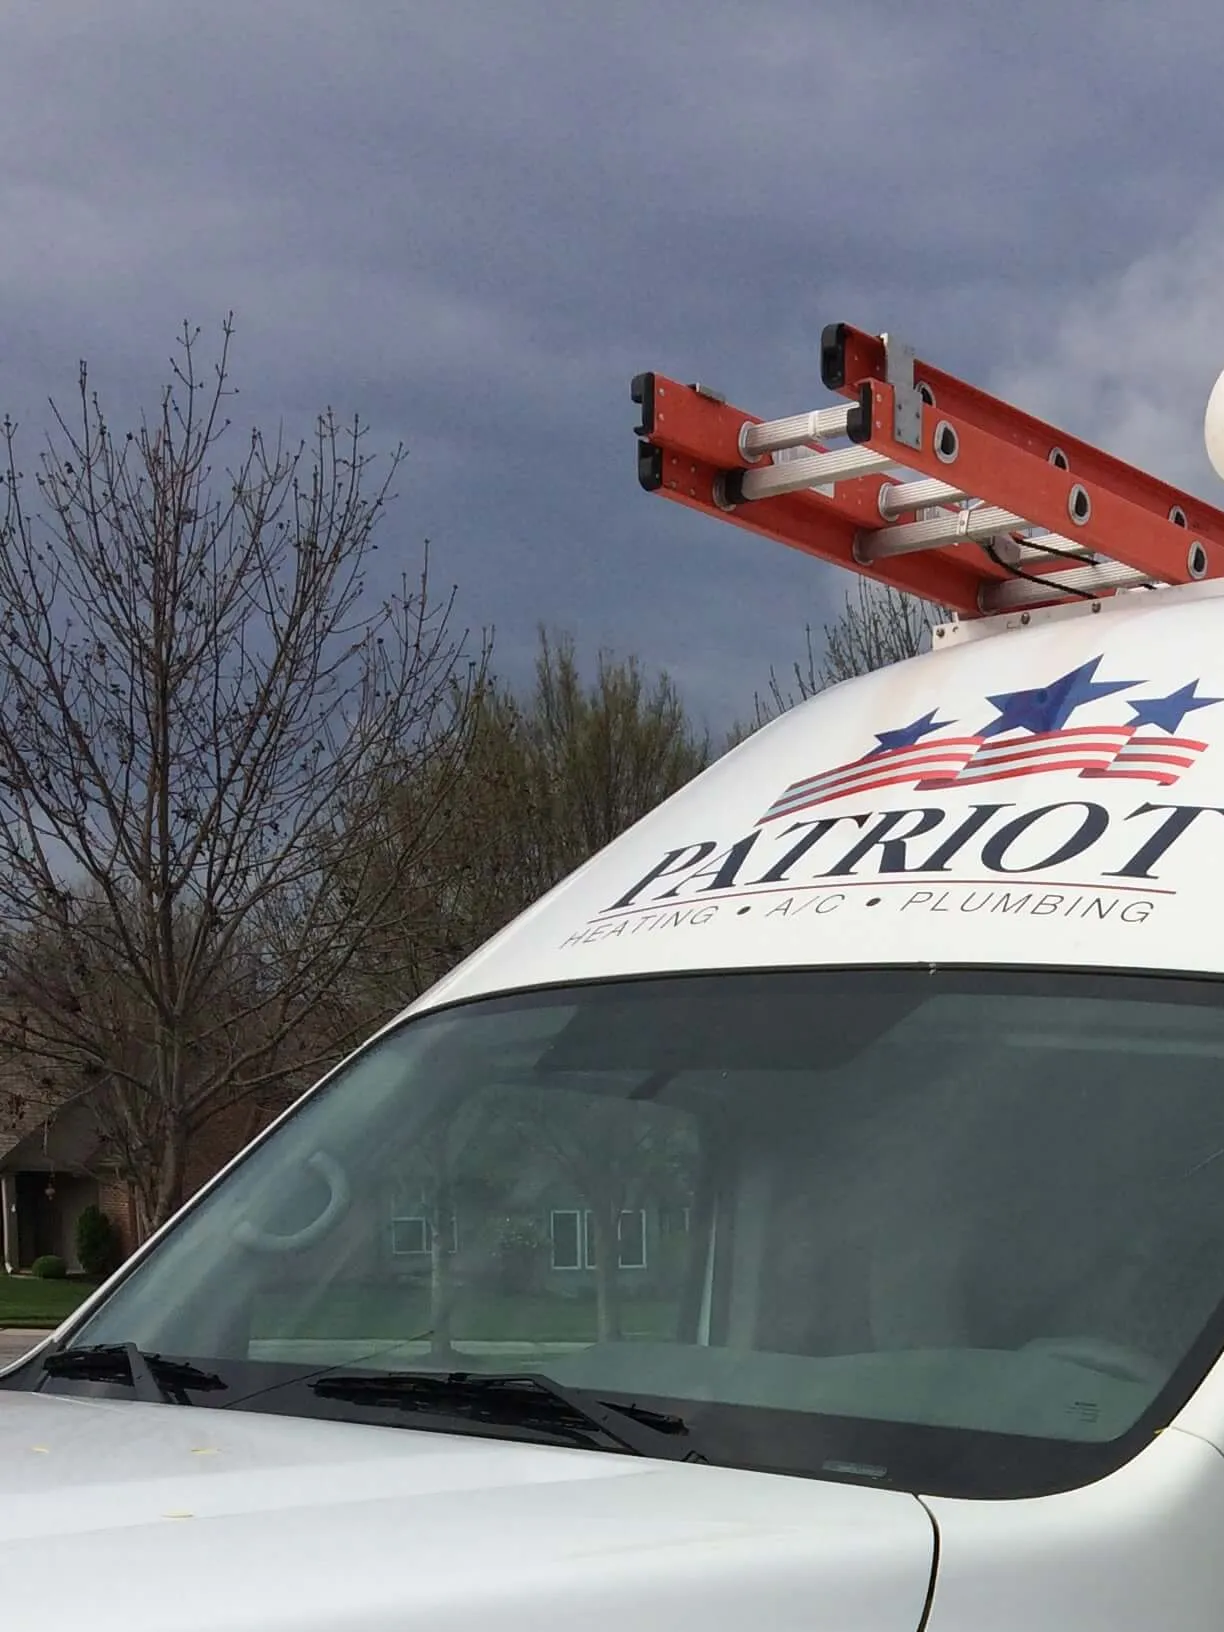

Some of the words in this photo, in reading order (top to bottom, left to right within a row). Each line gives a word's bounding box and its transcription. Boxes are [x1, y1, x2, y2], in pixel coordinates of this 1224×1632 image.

[560, 905, 719, 949] HEATING
[766, 894, 845, 916] A/C
[900, 890, 1155, 923] PLUMBING
